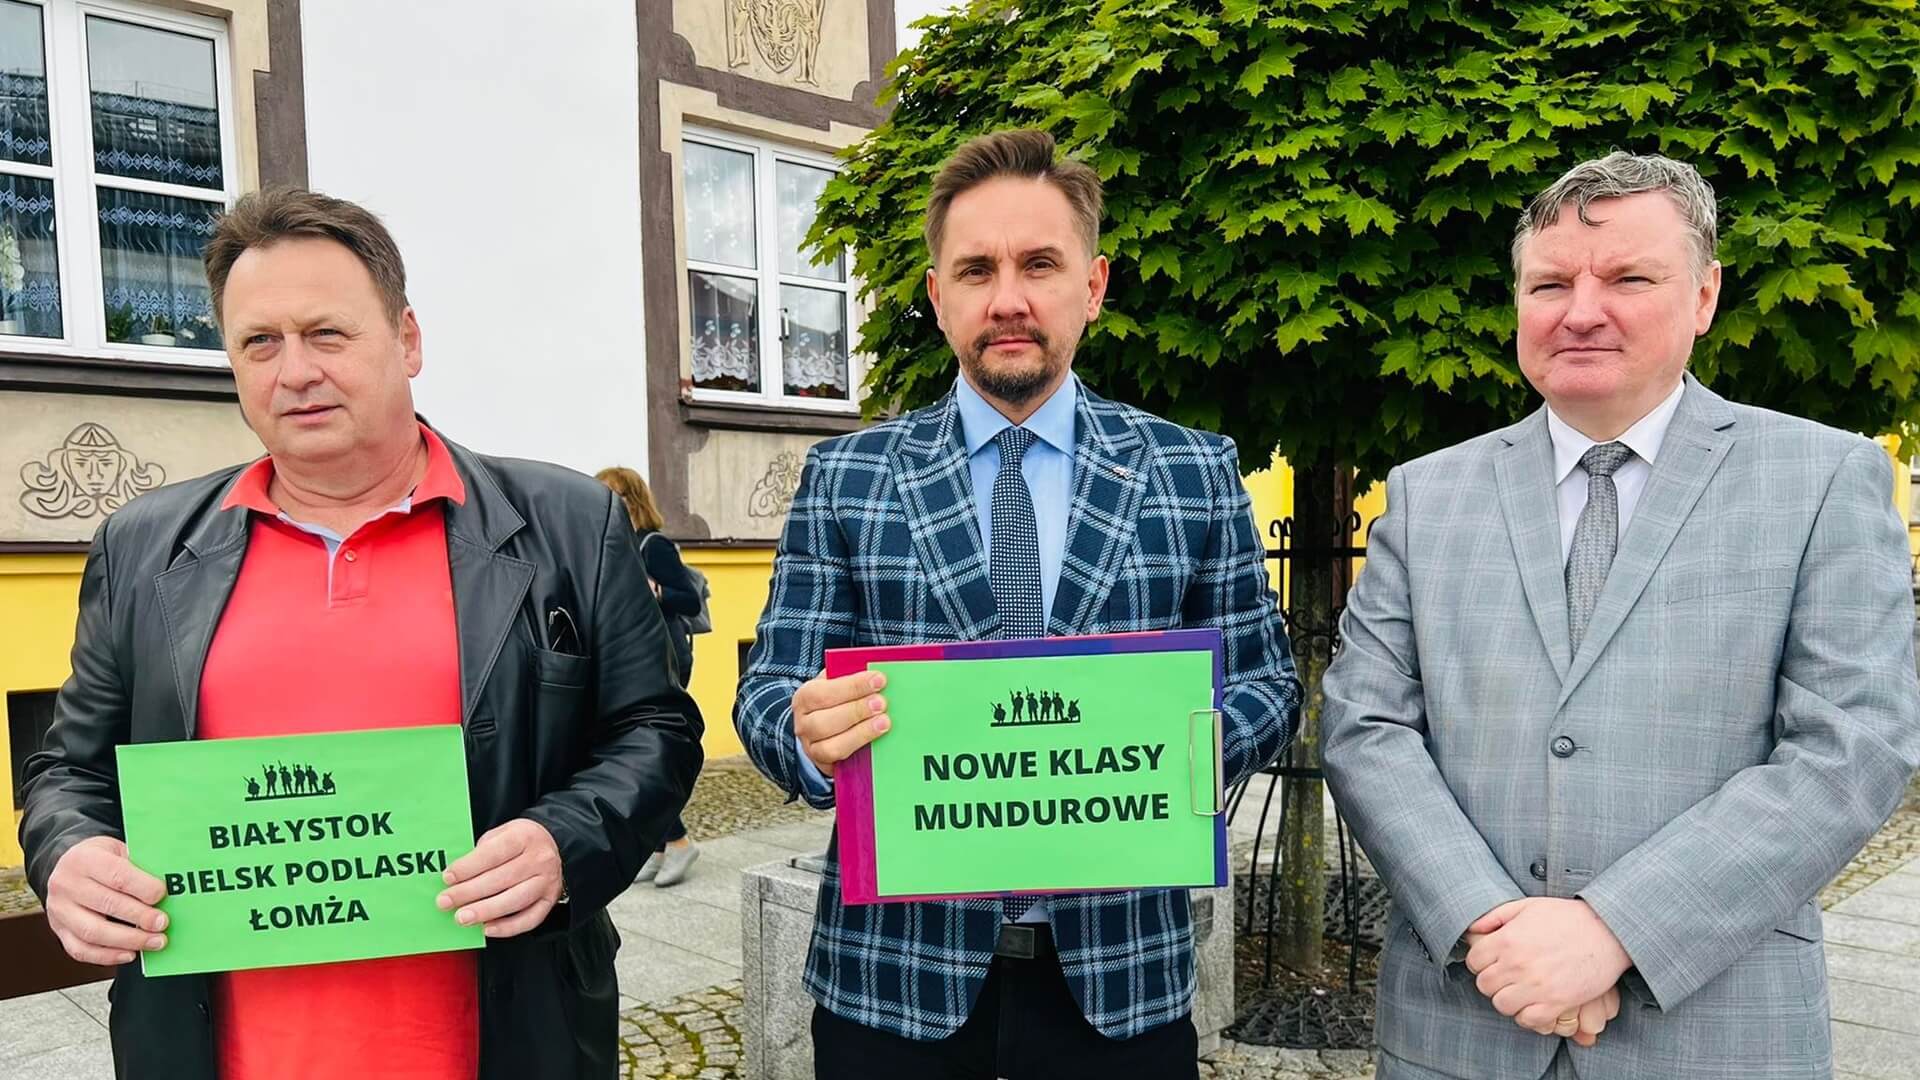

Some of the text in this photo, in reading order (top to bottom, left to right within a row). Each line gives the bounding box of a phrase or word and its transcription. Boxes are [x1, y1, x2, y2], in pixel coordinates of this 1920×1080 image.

[923, 743, 1166, 781] NOWE KLASY
[209, 812, 393, 849] BIAŁYSTOK
[914, 792, 1169, 831] MUNDUROWE
[165, 850, 447, 896] BIELSK PODLASKI
[249, 895, 369, 931] ŁOMŻA
